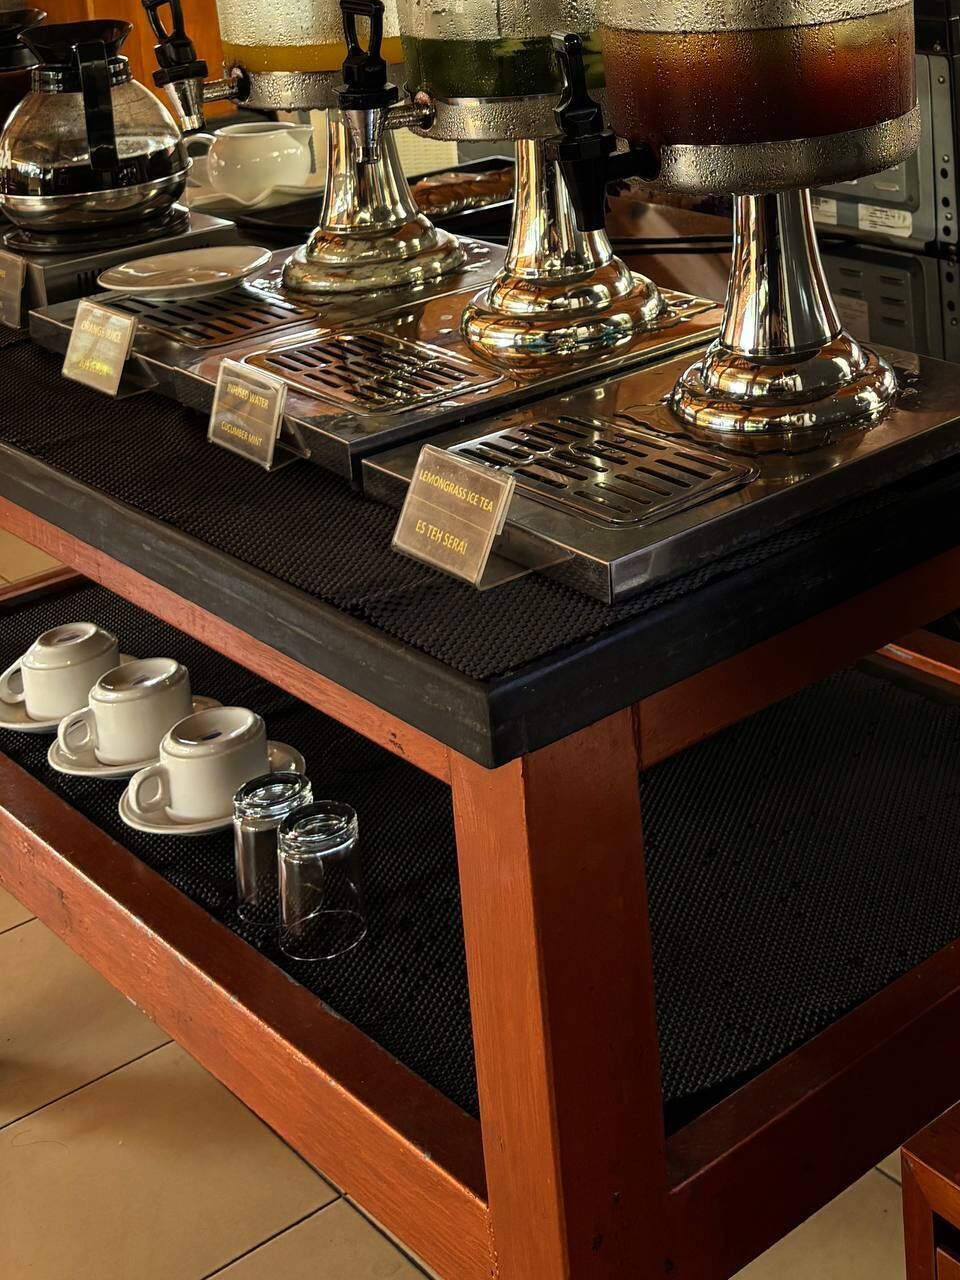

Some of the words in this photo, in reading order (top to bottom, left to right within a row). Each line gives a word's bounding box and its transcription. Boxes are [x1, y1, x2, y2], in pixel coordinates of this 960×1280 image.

[226, 383, 249, 400] INFUSED
[249, 391, 269, 409] WATER
[221, 421, 248, 441] CUCUMBER
[247, 434, 263, 447] MINT
[419, 469, 468, 500] LEMONGRASS
[466, 491, 480, 506] ICE
[479, 498, 494, 513] TEA
[415, 519, 427, 535] ES
[426, 525, 443, 543] TEH
[442, 532, 468, 555] SERAI
